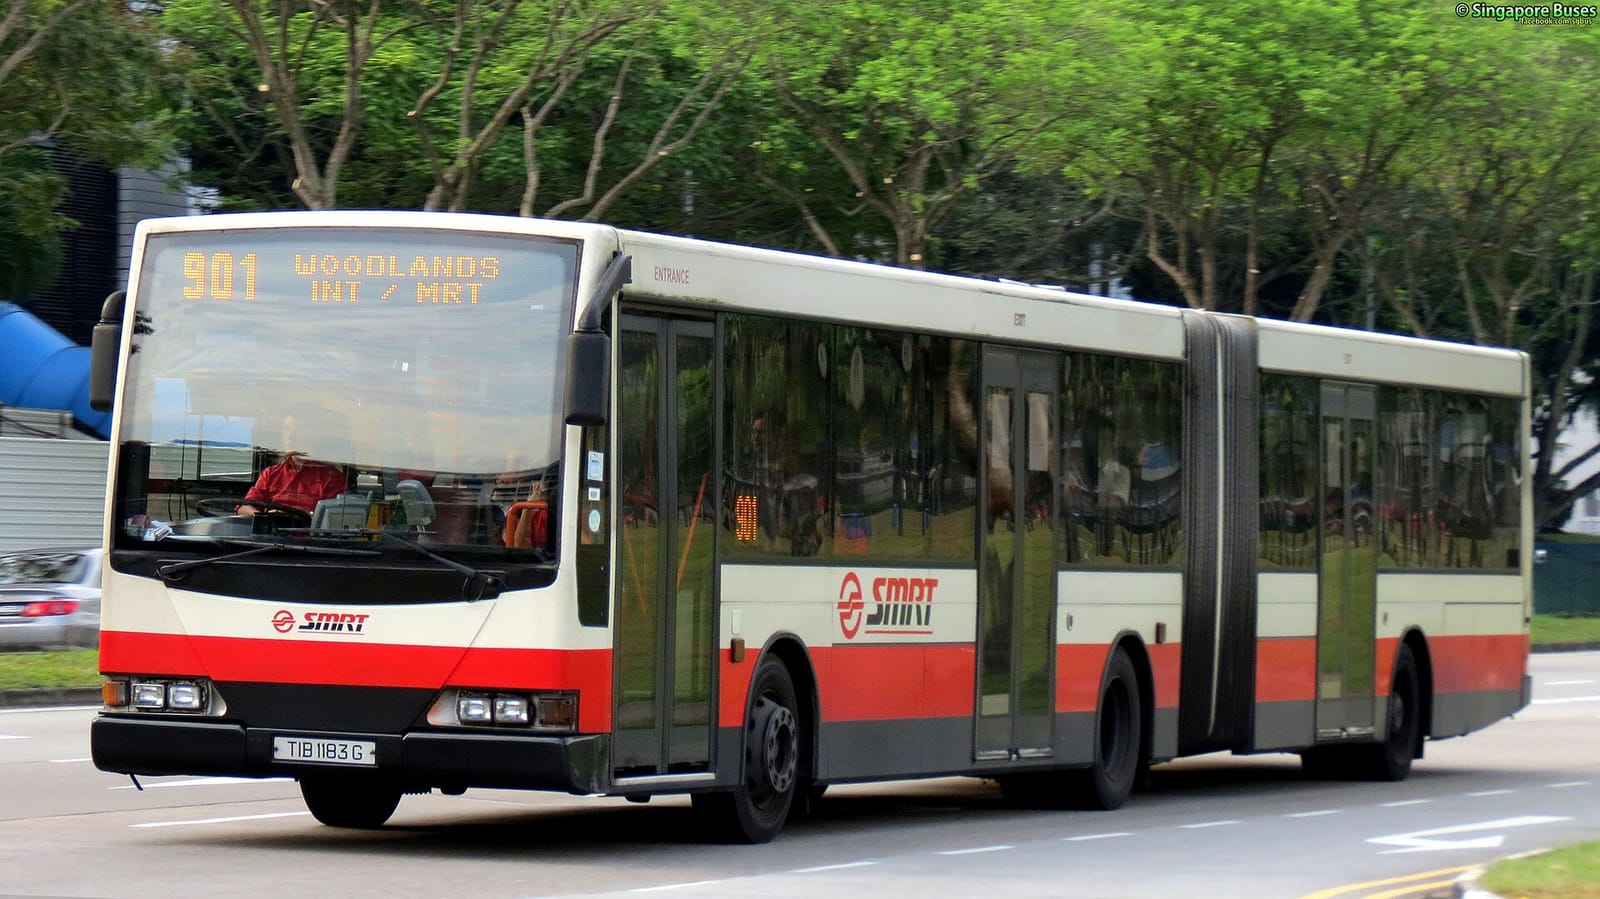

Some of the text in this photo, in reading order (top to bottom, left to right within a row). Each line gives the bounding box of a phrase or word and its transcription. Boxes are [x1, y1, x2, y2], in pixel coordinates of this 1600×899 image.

[183, 252, 257, 300] 901
[295, 254, 500, 278] WOODLANDS
[654, 266, 689, 284] ENTRANCE
[312, 280, 362, 302] INT
[416, 282, 483, 304] MRT
[866, 578, 938, 625] SMRT
[299, 612, 370, 632] SMRT
